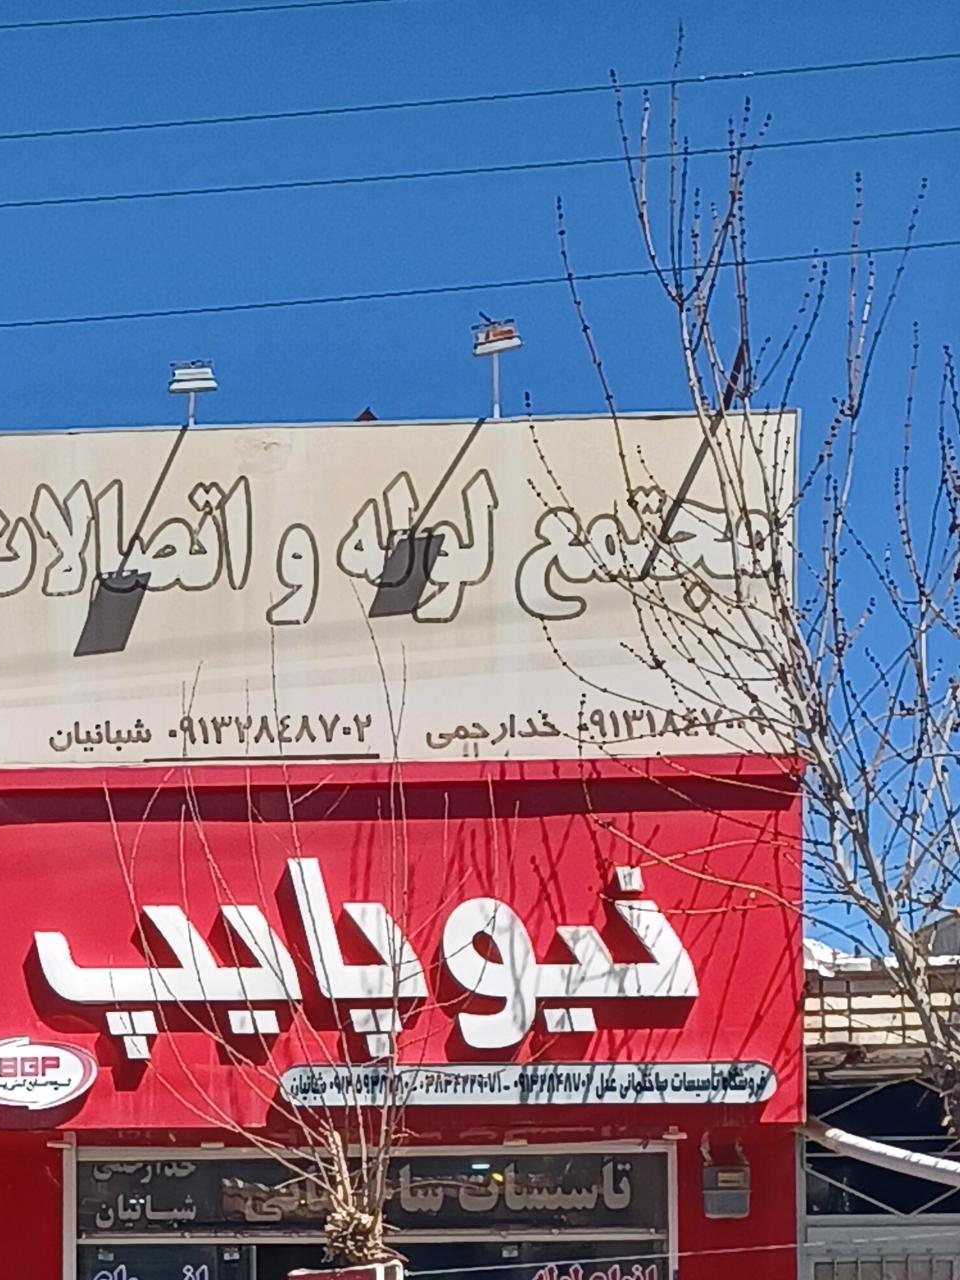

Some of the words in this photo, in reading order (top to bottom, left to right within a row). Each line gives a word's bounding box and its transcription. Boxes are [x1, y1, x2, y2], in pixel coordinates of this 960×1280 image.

[265, 522, 320, 625] و
[337, 468, 500, 624] لوله
[515, 484, 784, 621] مجتمع
[38, 717, 153, 752] شبانیان
[95, 1193, 198, 1229] شبانیان
